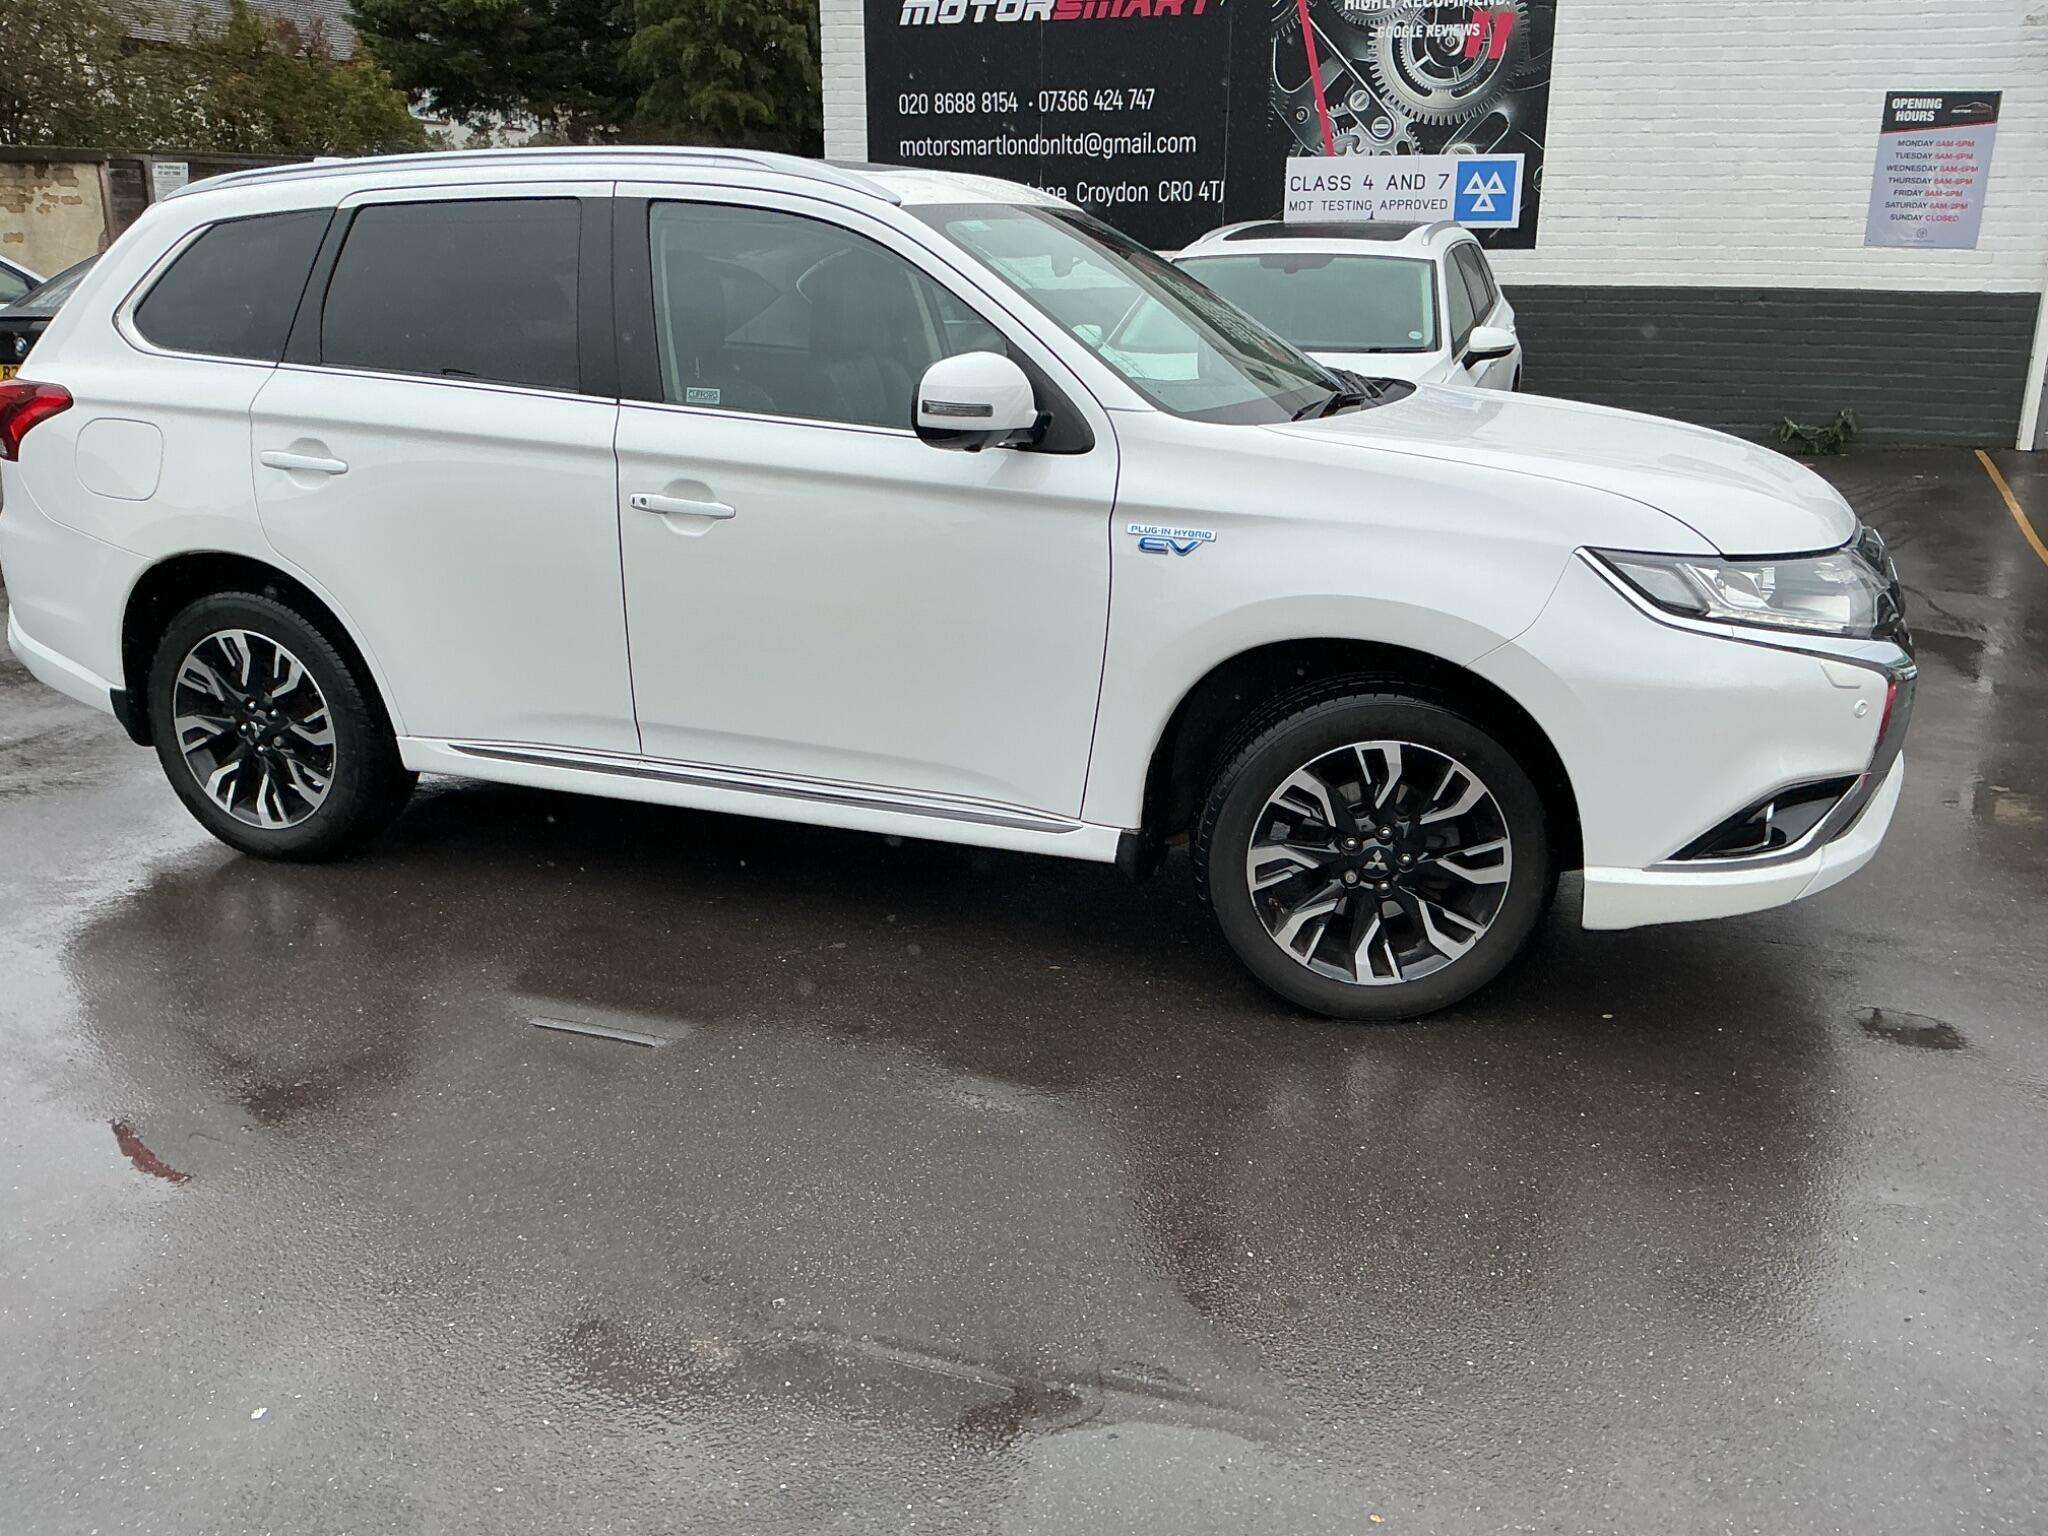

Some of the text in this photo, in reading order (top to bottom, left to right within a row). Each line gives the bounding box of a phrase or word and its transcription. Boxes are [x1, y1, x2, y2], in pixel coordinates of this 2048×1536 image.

[1378, 23, 1480, 39] GOOGLE REVIEWS
[899, 88, 1155, 114] 020 8688 8154 07366 424 747
[1892, 98, 1943, 109] OPENING
[1895, 110, 1935, 122] HOURS
[900, 133, 1197, 159] motorsmartlondonltd@gmail.com
[1886, 164, 1938, 172] WEDNESDAY
[1290, 173, 1450, 193] CLASS 4 AND 7
[1076, 181, 1149, 207] Croydon
[1893, 189, 1923, 197] FRIDAY
[1288, 199, 1448, 212] MOT TESTING APPROVED
[1885, 201, 1928, 209] SATURDAY
[1925, 214, 1960, 222] CLOSED
[1131, 525, 1212, 539] PLUG-IN HYBRID
[1138, 537, 1204, 556] EV
